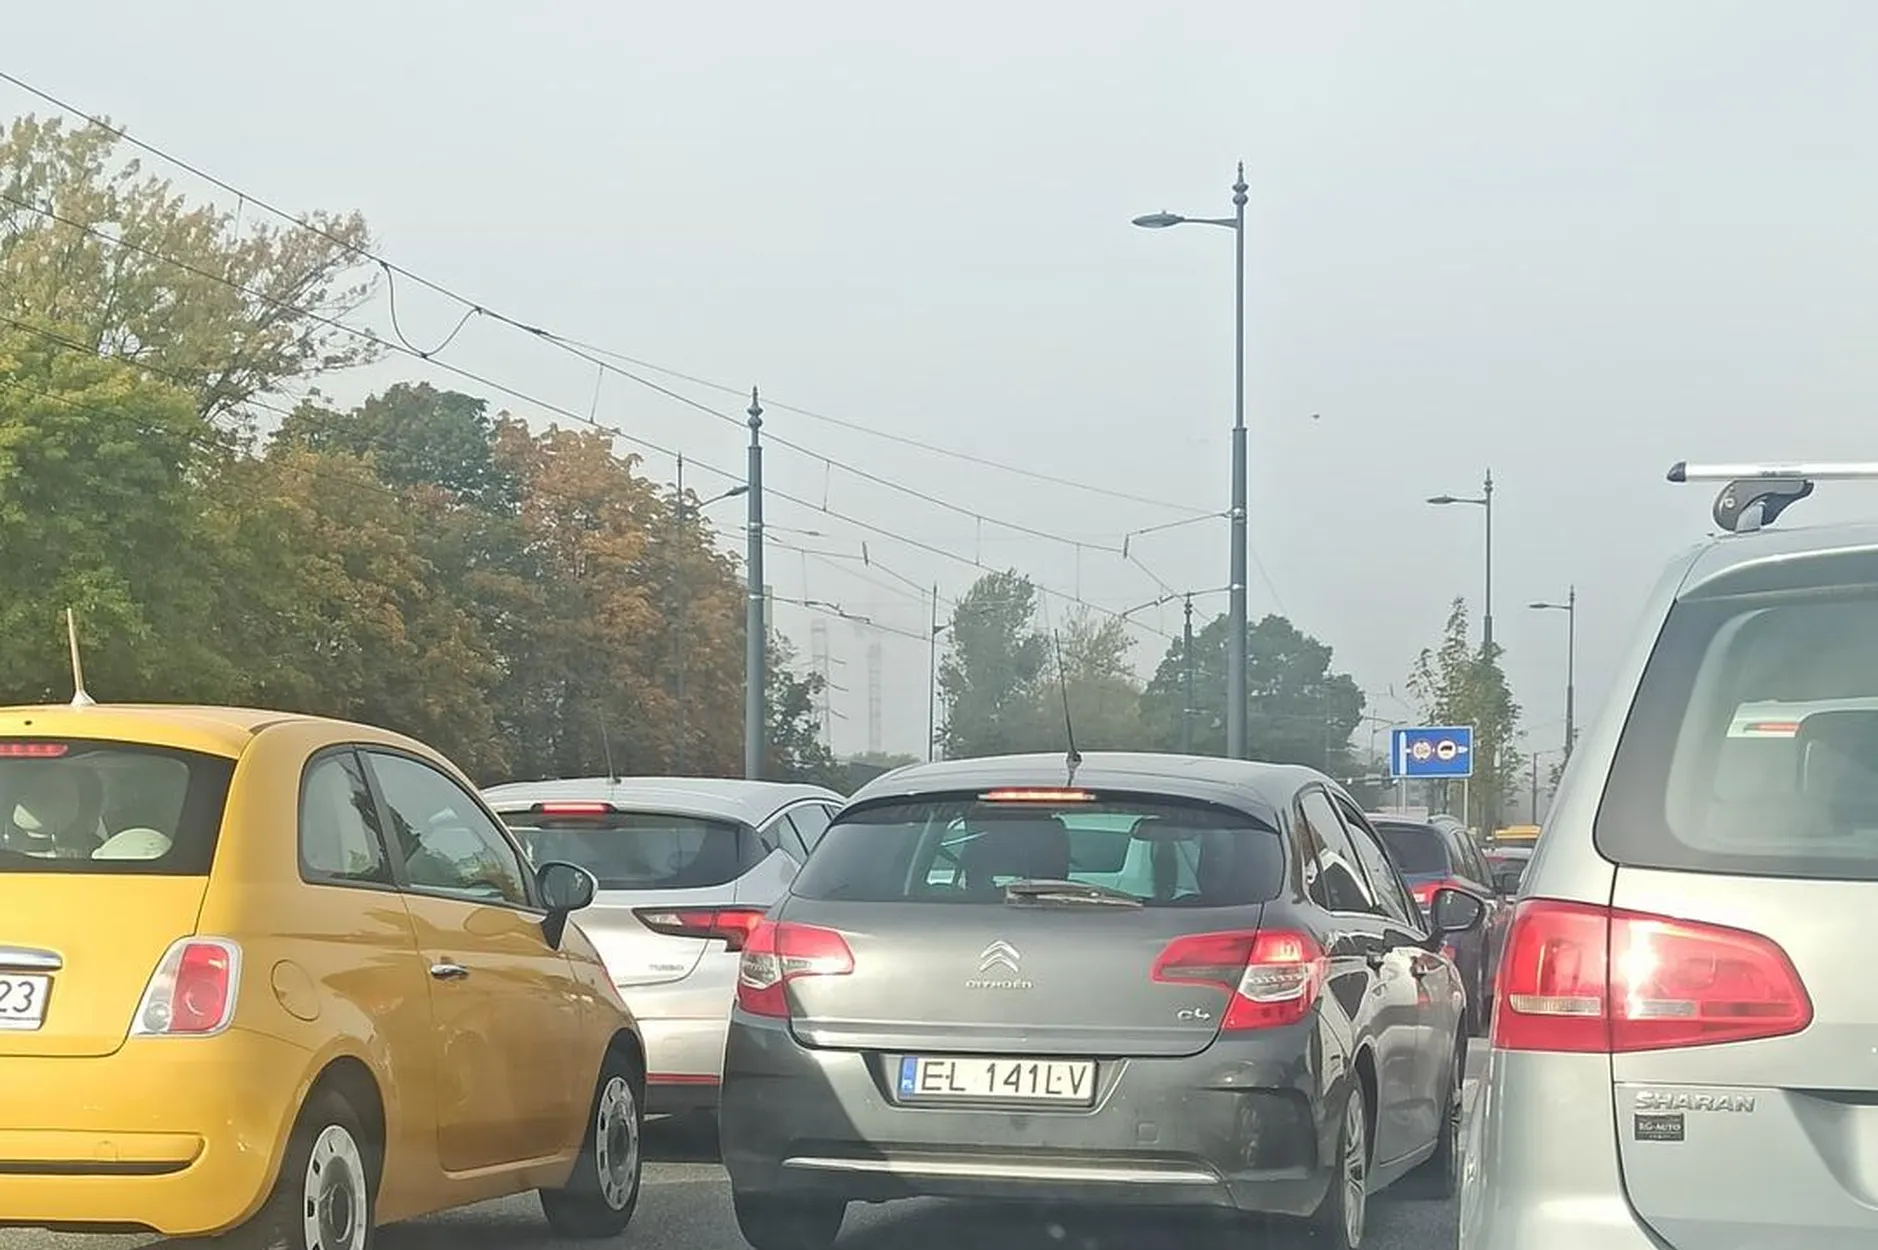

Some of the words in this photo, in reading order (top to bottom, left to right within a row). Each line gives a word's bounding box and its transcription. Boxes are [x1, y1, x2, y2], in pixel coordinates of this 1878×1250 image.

[921, 1060, 966, 1092] EL
[986, 1062, 1087, 1096] 141LV
[1635, 1091, 1755, 1112] SHARAN
